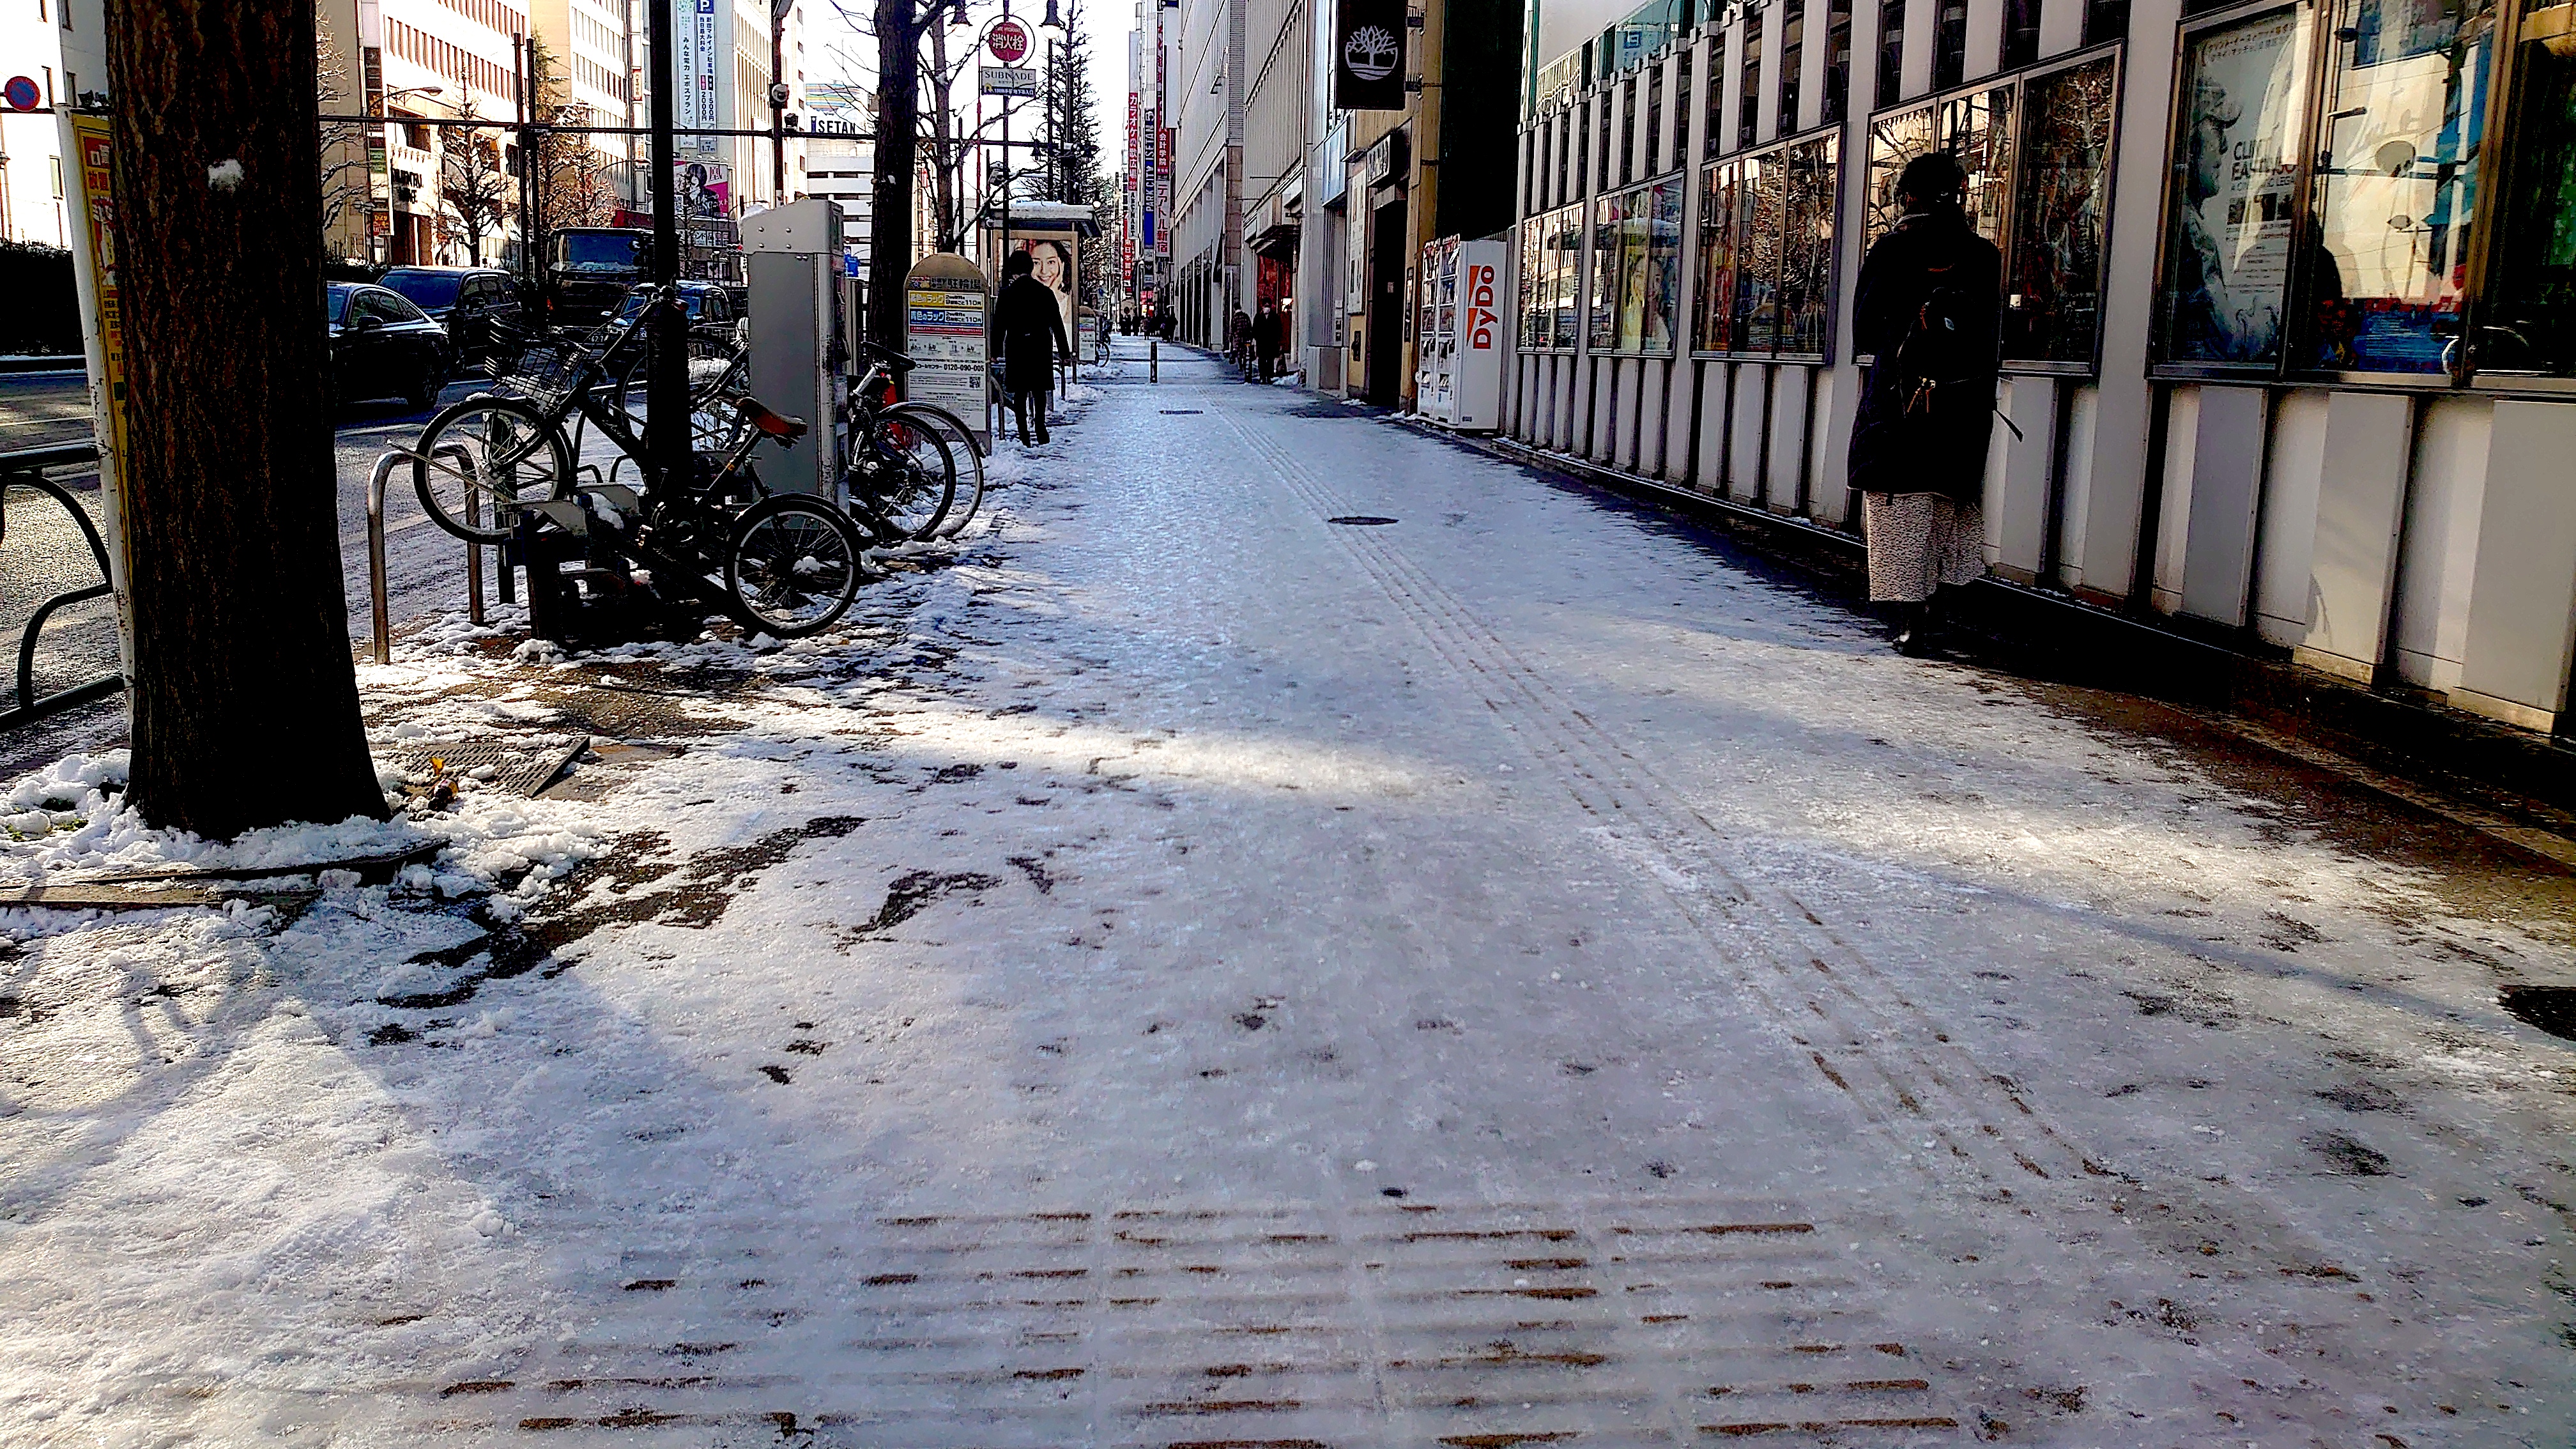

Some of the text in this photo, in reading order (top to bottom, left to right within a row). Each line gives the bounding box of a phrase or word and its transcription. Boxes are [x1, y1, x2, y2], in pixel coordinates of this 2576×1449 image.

[992, 33, 1024, 50] 消火栓
[985, 72, 1033, 80] SUBNADE
[810, 116, 856, 134] ISETAN
[1145, 125, 1154, 160] ISETAN
[1146, 165, 1154, 188] CITY
[1146, 190, 1154, 212] PARK
[1157, 184, 1168, 253] テアトル新宿
[948, 279, 981, 290] 駐輪場
[1473, 264, 1498, 349] DyDo
[944, 364, 985, 372] 0120-090-005
